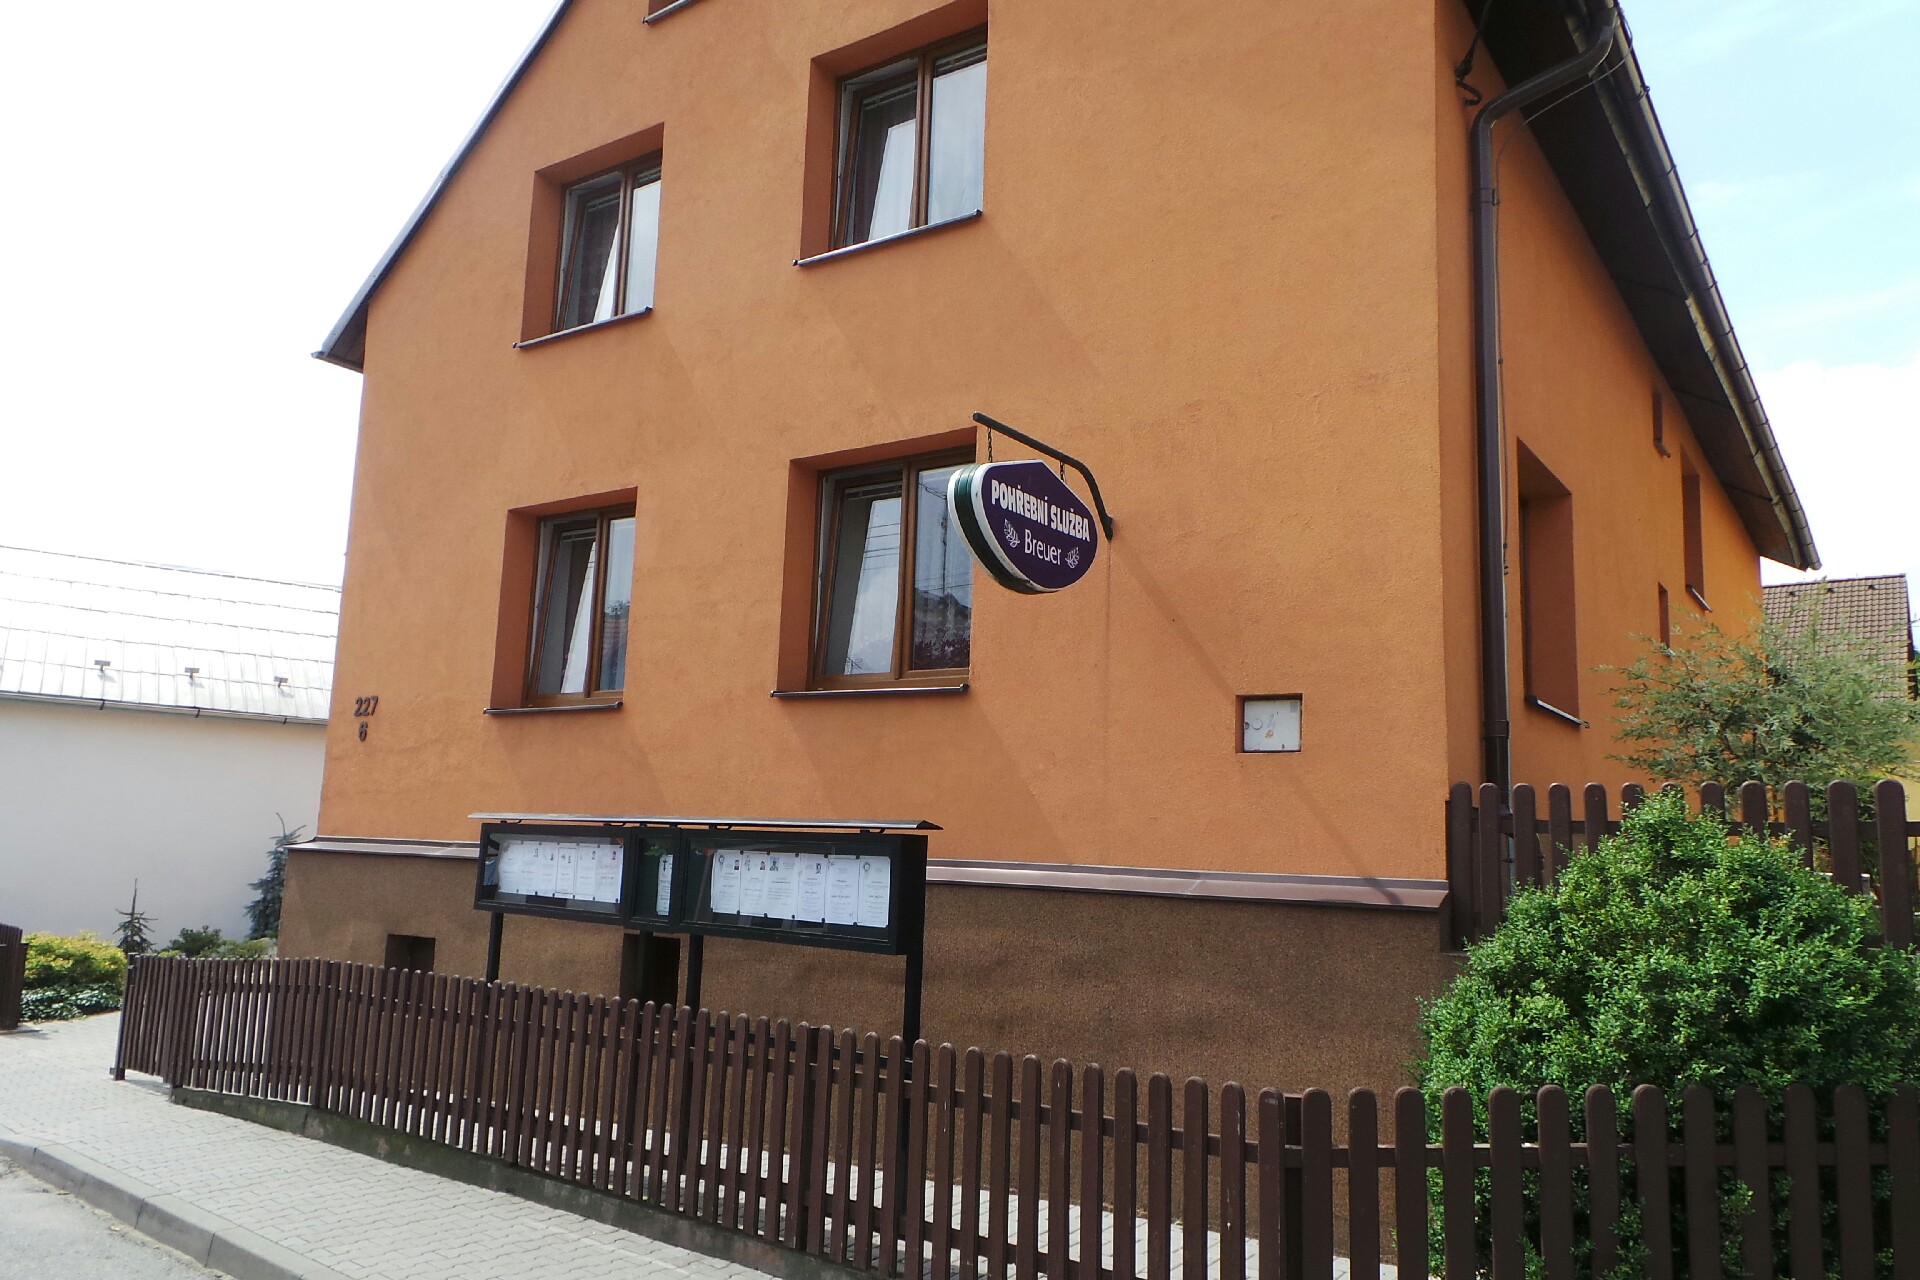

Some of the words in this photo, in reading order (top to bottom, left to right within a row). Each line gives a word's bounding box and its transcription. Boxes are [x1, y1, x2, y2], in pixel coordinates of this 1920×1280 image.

[991, 479, 1048, 526] POHŘEBNÍ
[1050, 504, 1090, 542] SLUŽBA
[1024, 528, 1061, 565] Breuer
[354, 695, 379, 716] 227
[359, 721, 368, 742] 6
